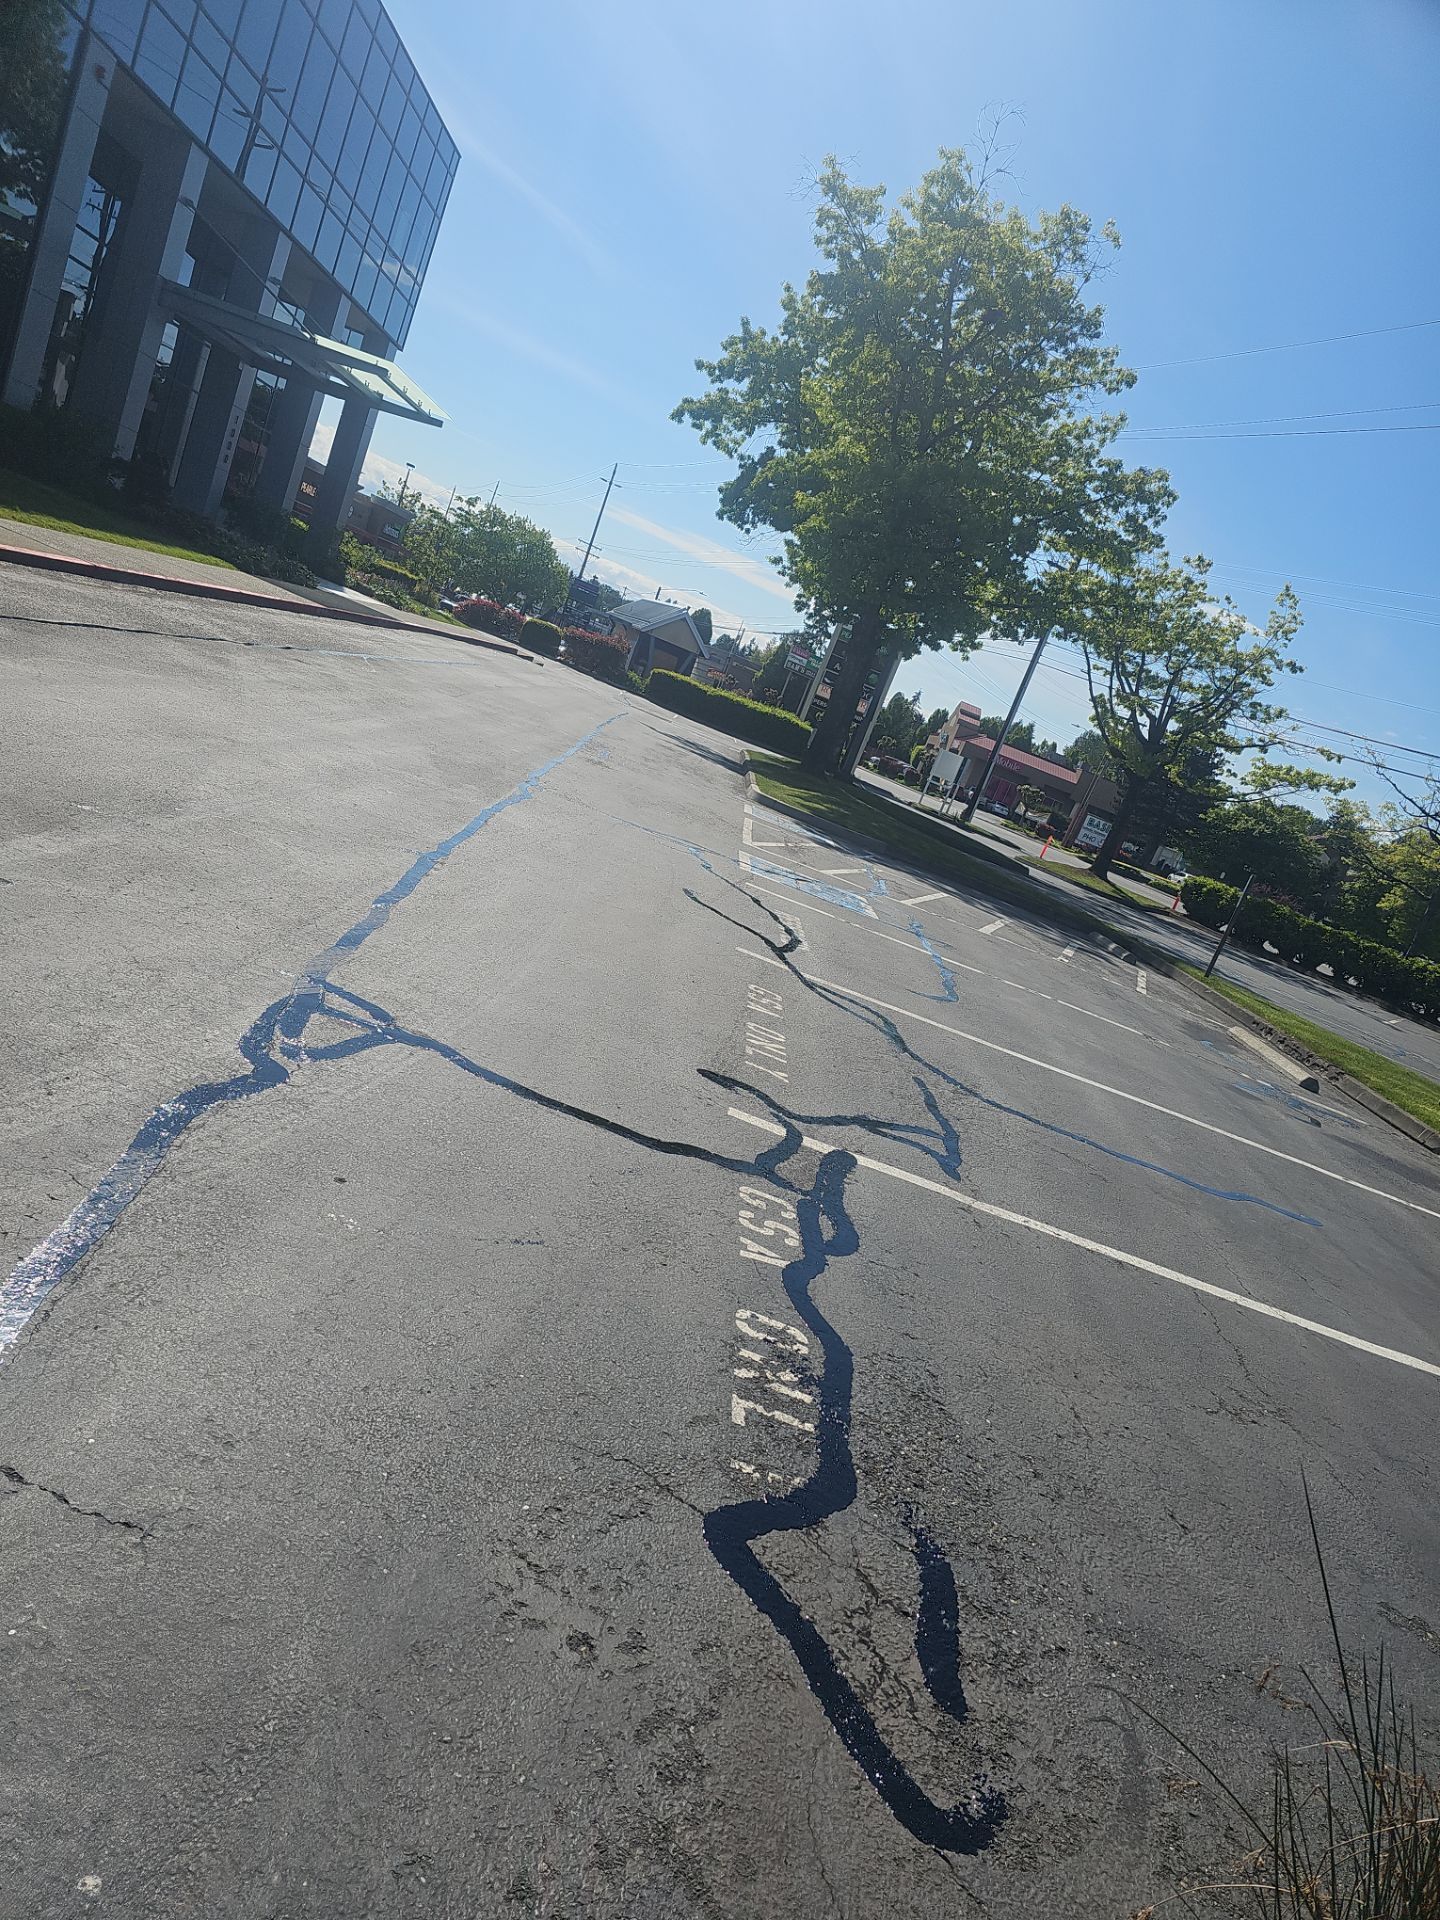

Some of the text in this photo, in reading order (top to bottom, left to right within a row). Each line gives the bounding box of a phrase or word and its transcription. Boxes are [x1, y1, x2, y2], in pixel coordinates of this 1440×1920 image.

[745, 983, 789, 1083] GSA ONLY
[738, 1186, 801, 1267] GSA
